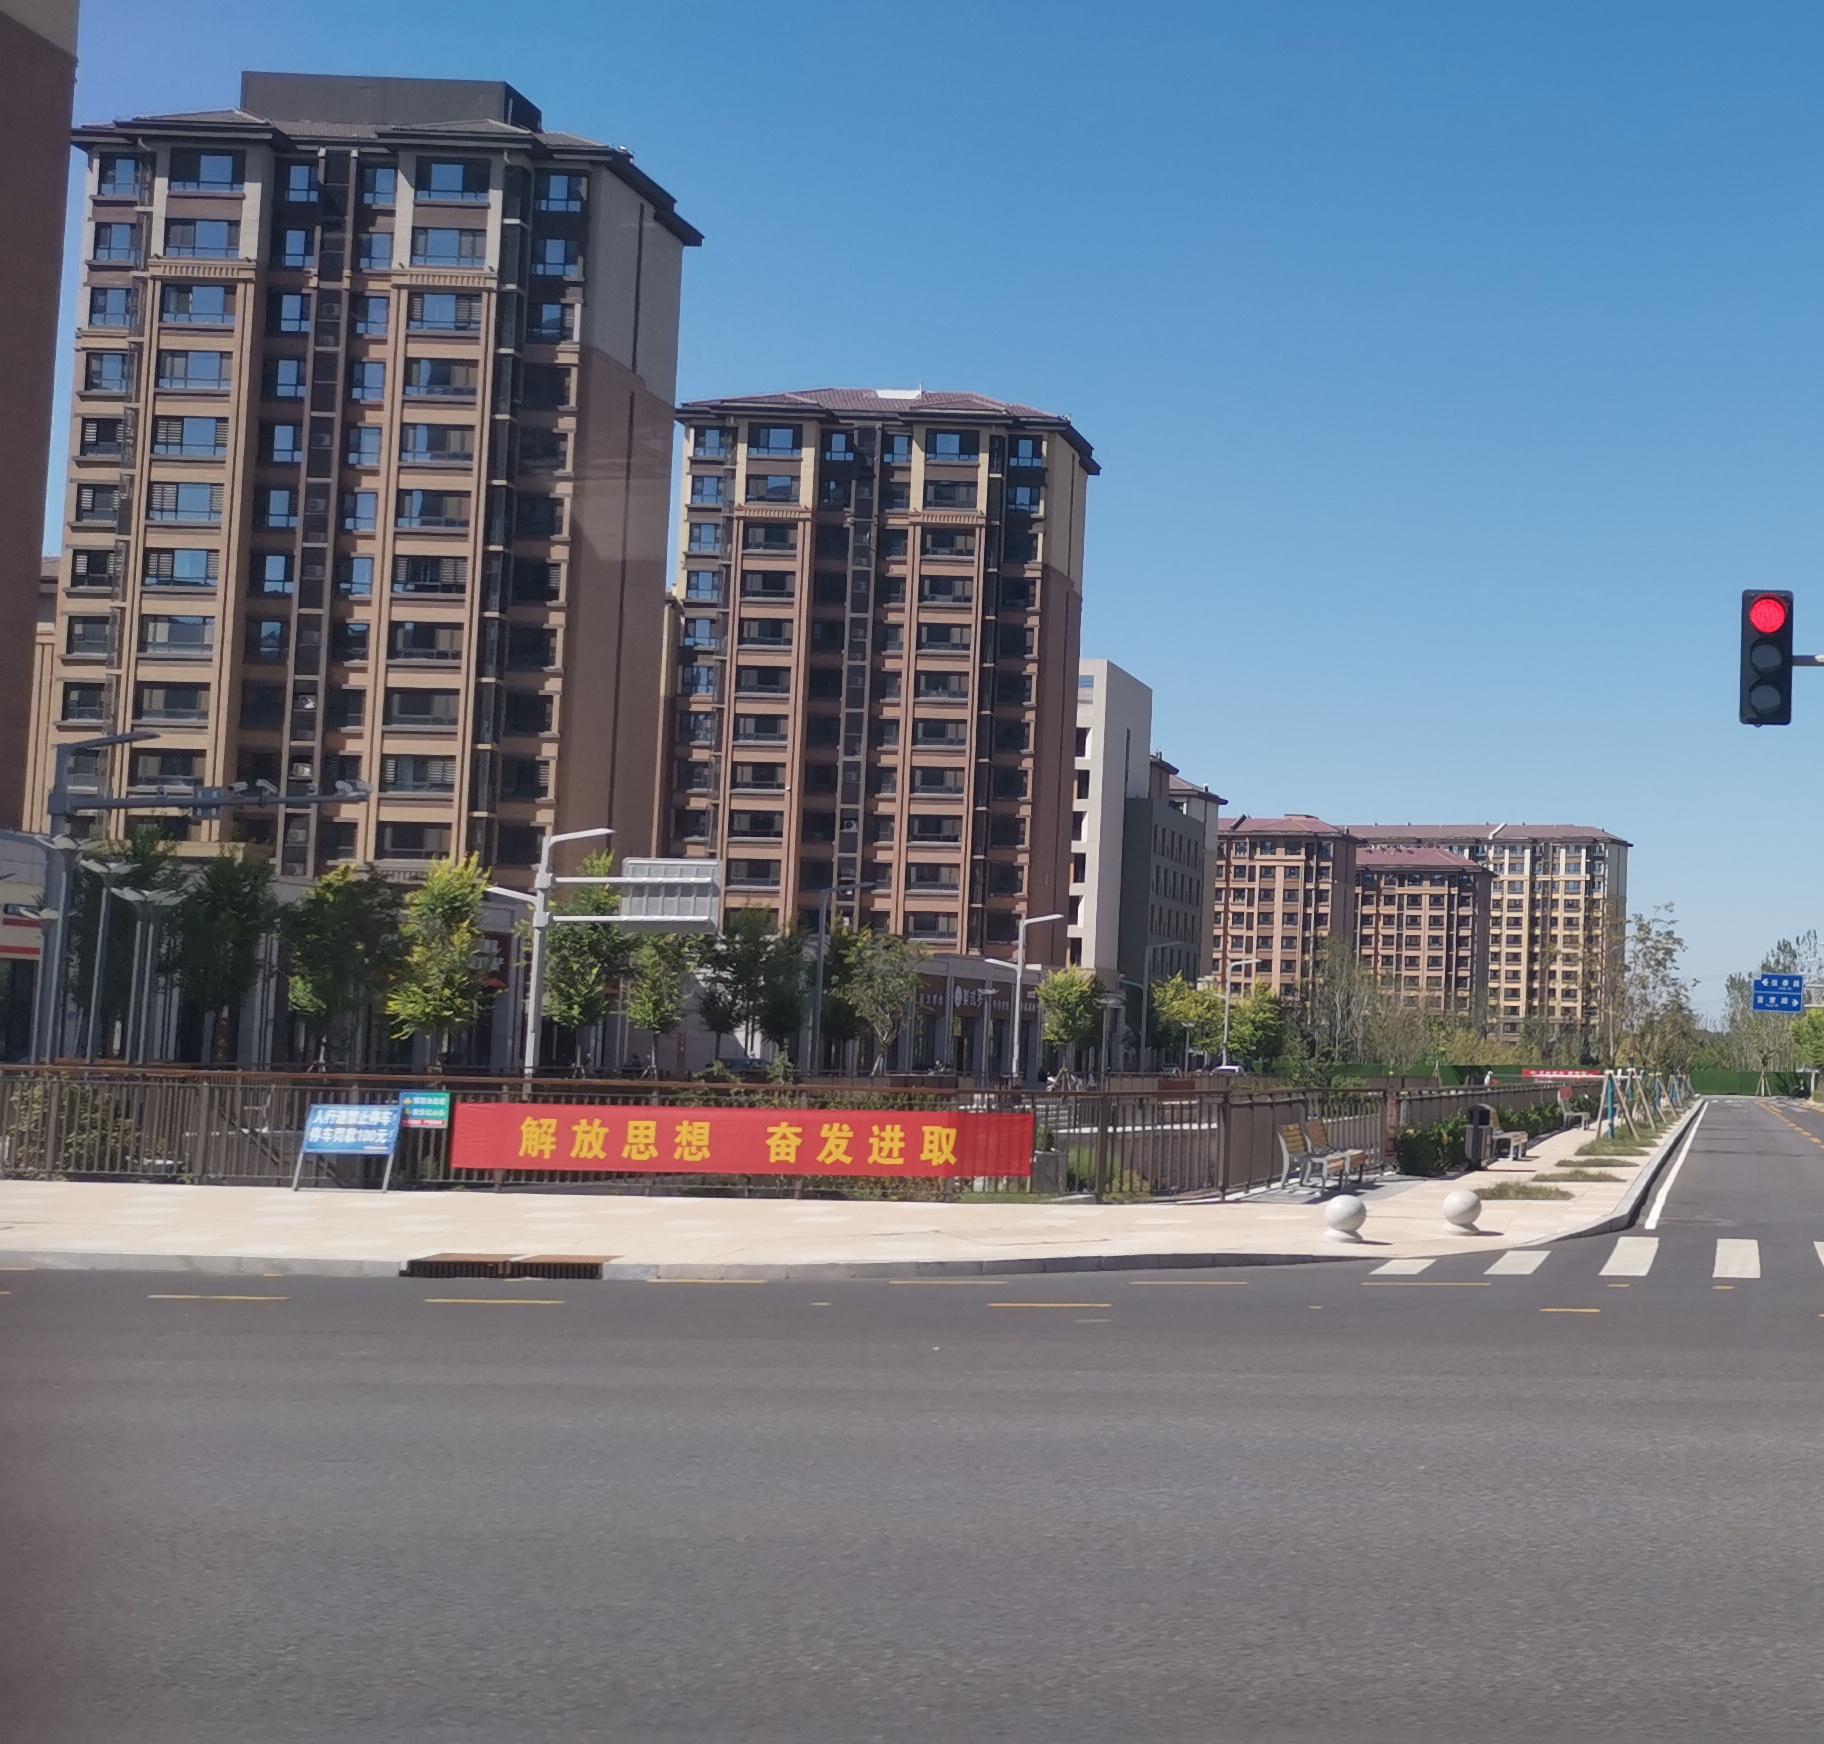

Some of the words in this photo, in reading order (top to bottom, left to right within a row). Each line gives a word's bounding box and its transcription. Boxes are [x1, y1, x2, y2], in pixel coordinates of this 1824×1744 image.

[519, 1116, 711, 1162] 解放思想
[766, 1121, 958, 1166] 奋发进取
